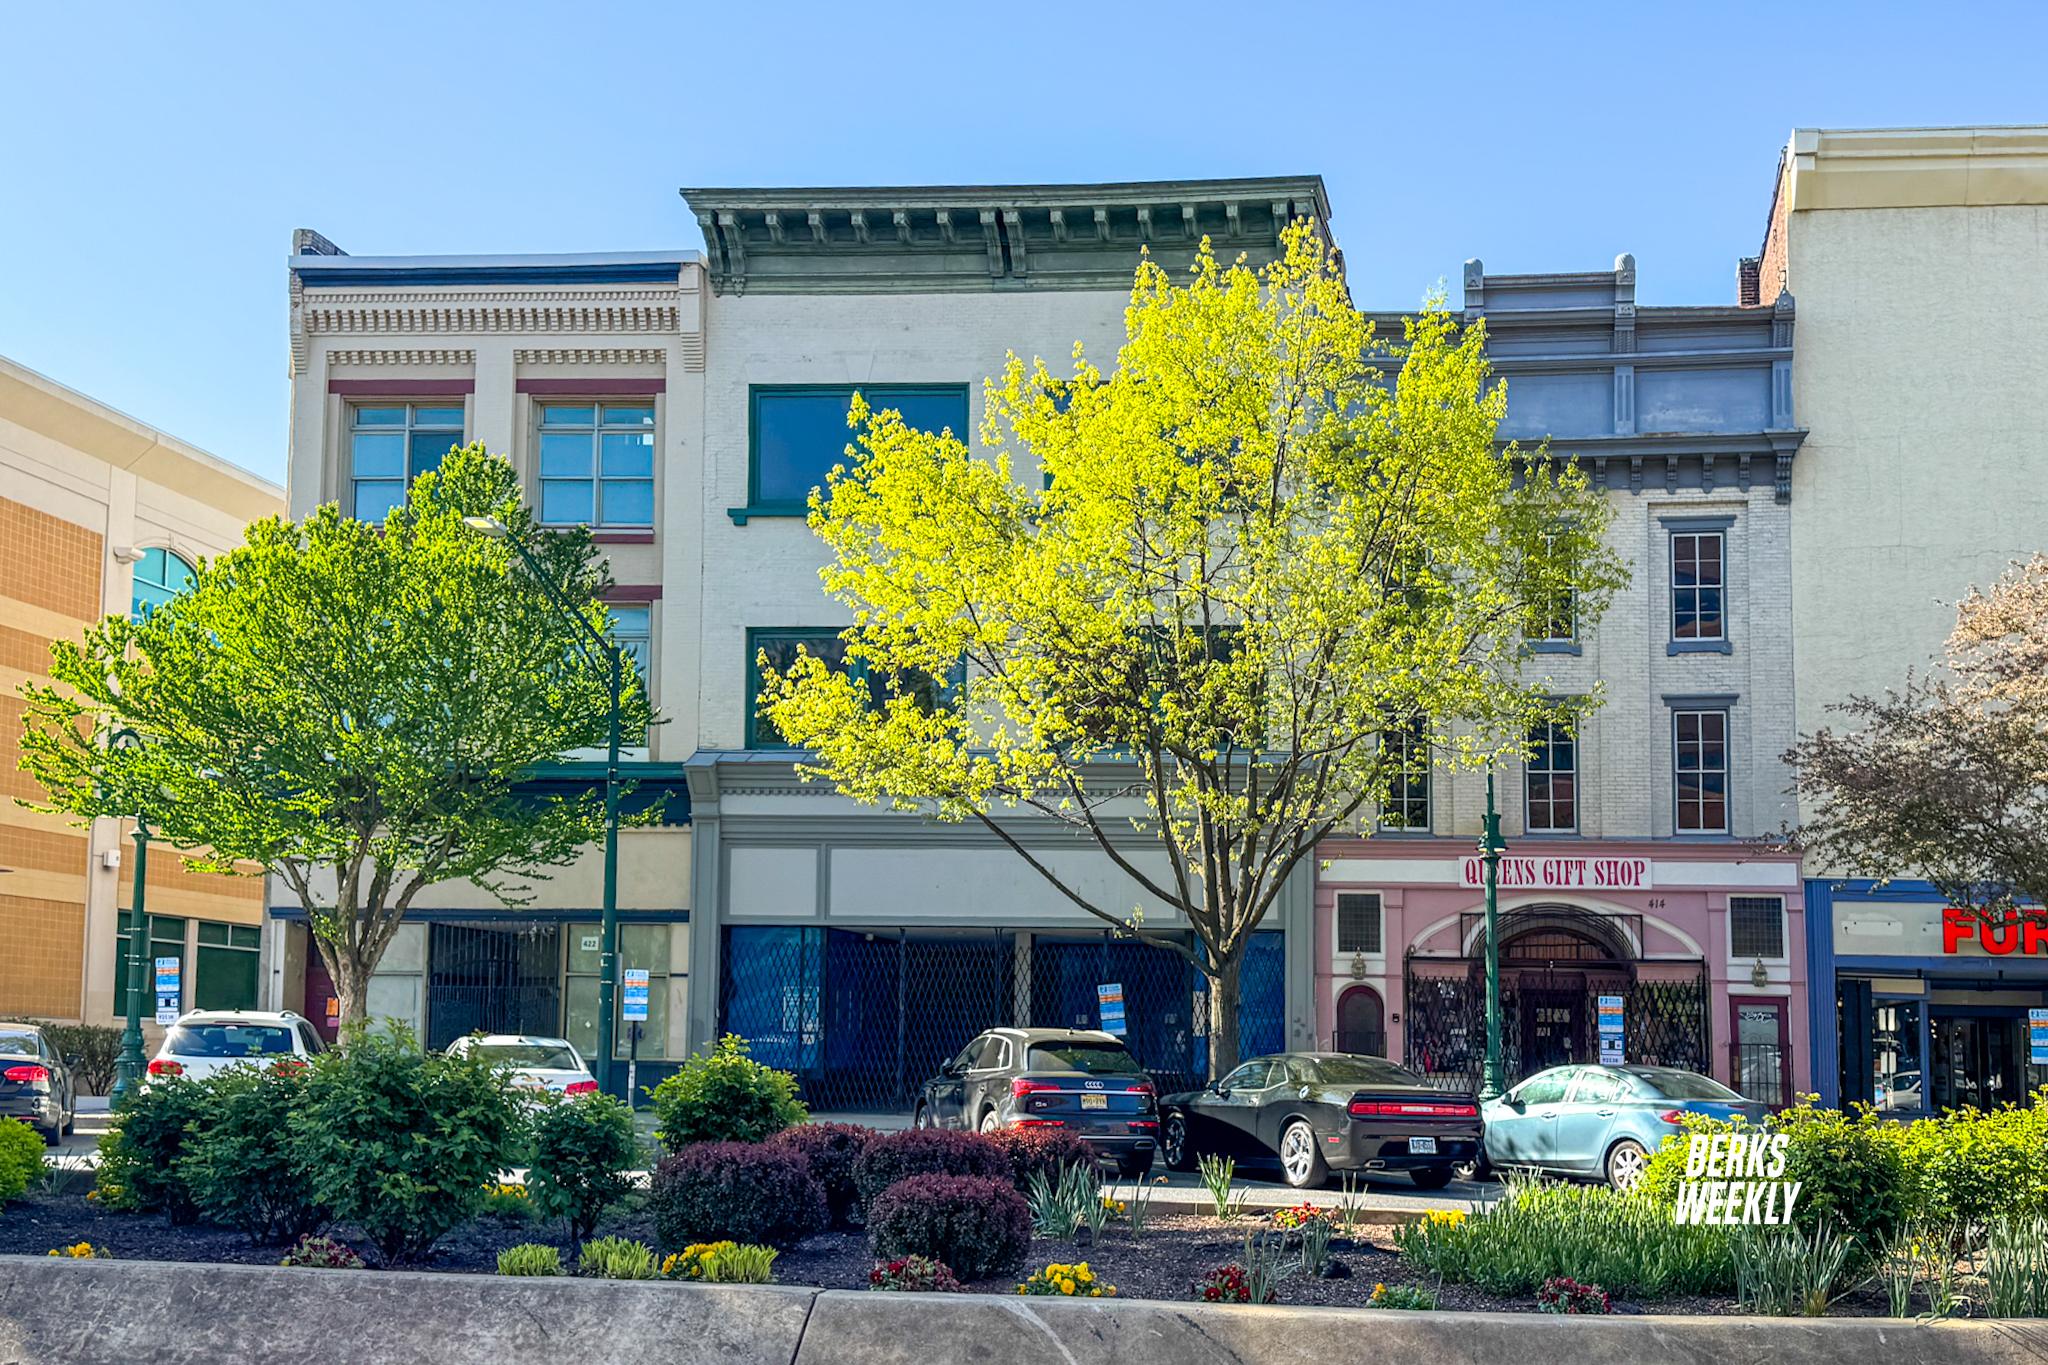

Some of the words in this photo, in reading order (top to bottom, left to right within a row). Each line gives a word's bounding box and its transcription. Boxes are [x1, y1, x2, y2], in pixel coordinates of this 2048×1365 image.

[1543, 859, 1587, 886] GIFT
[1594, 859, 1646, 887] SHOP
[1648, 898, 1666, 909] 414
[583, 940, 597, 948] 422
